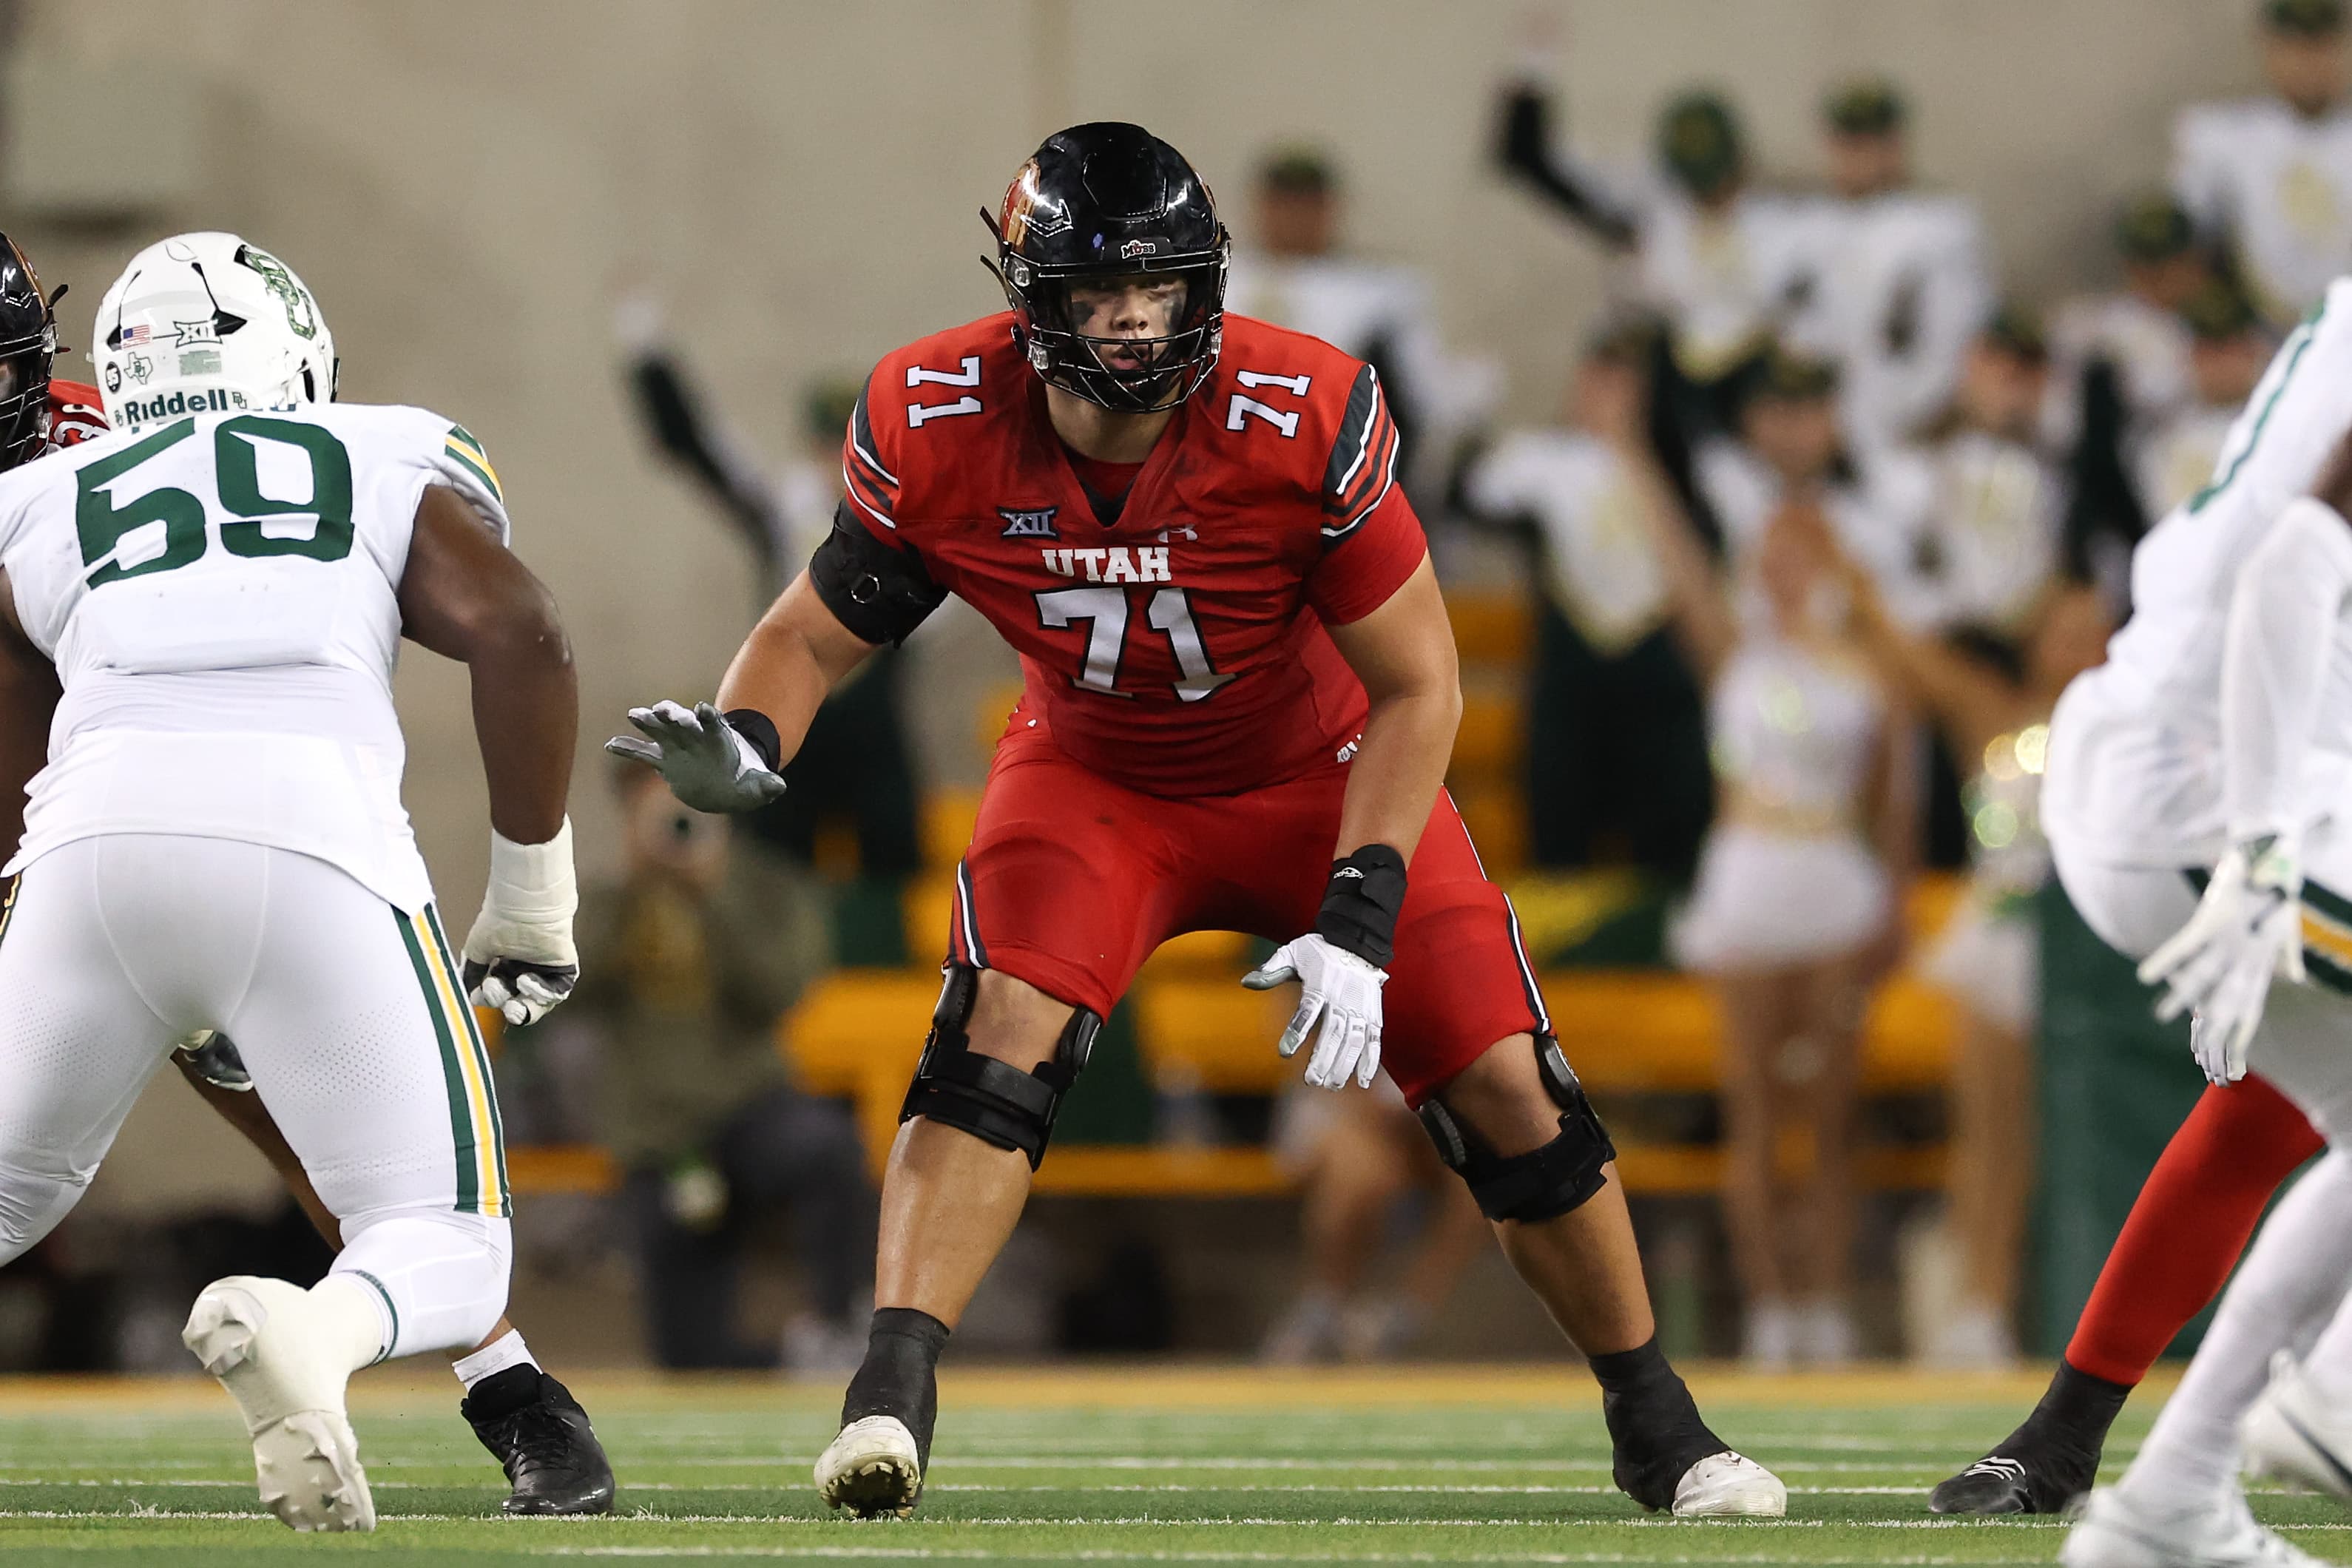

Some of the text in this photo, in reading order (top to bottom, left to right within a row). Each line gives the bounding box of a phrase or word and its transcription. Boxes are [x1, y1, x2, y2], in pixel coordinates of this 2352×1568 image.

[124, 388, 228, 425] Riddell
[906, 355, 983, 428] 71
[1226, 369, 1311, 438] 71
[75, 414, 355, 590] 59
[998, 507, 1061, 541] XII
[1041, 547, 1172, 584] UTAH
[1033, 586, 1238, 703] 71
